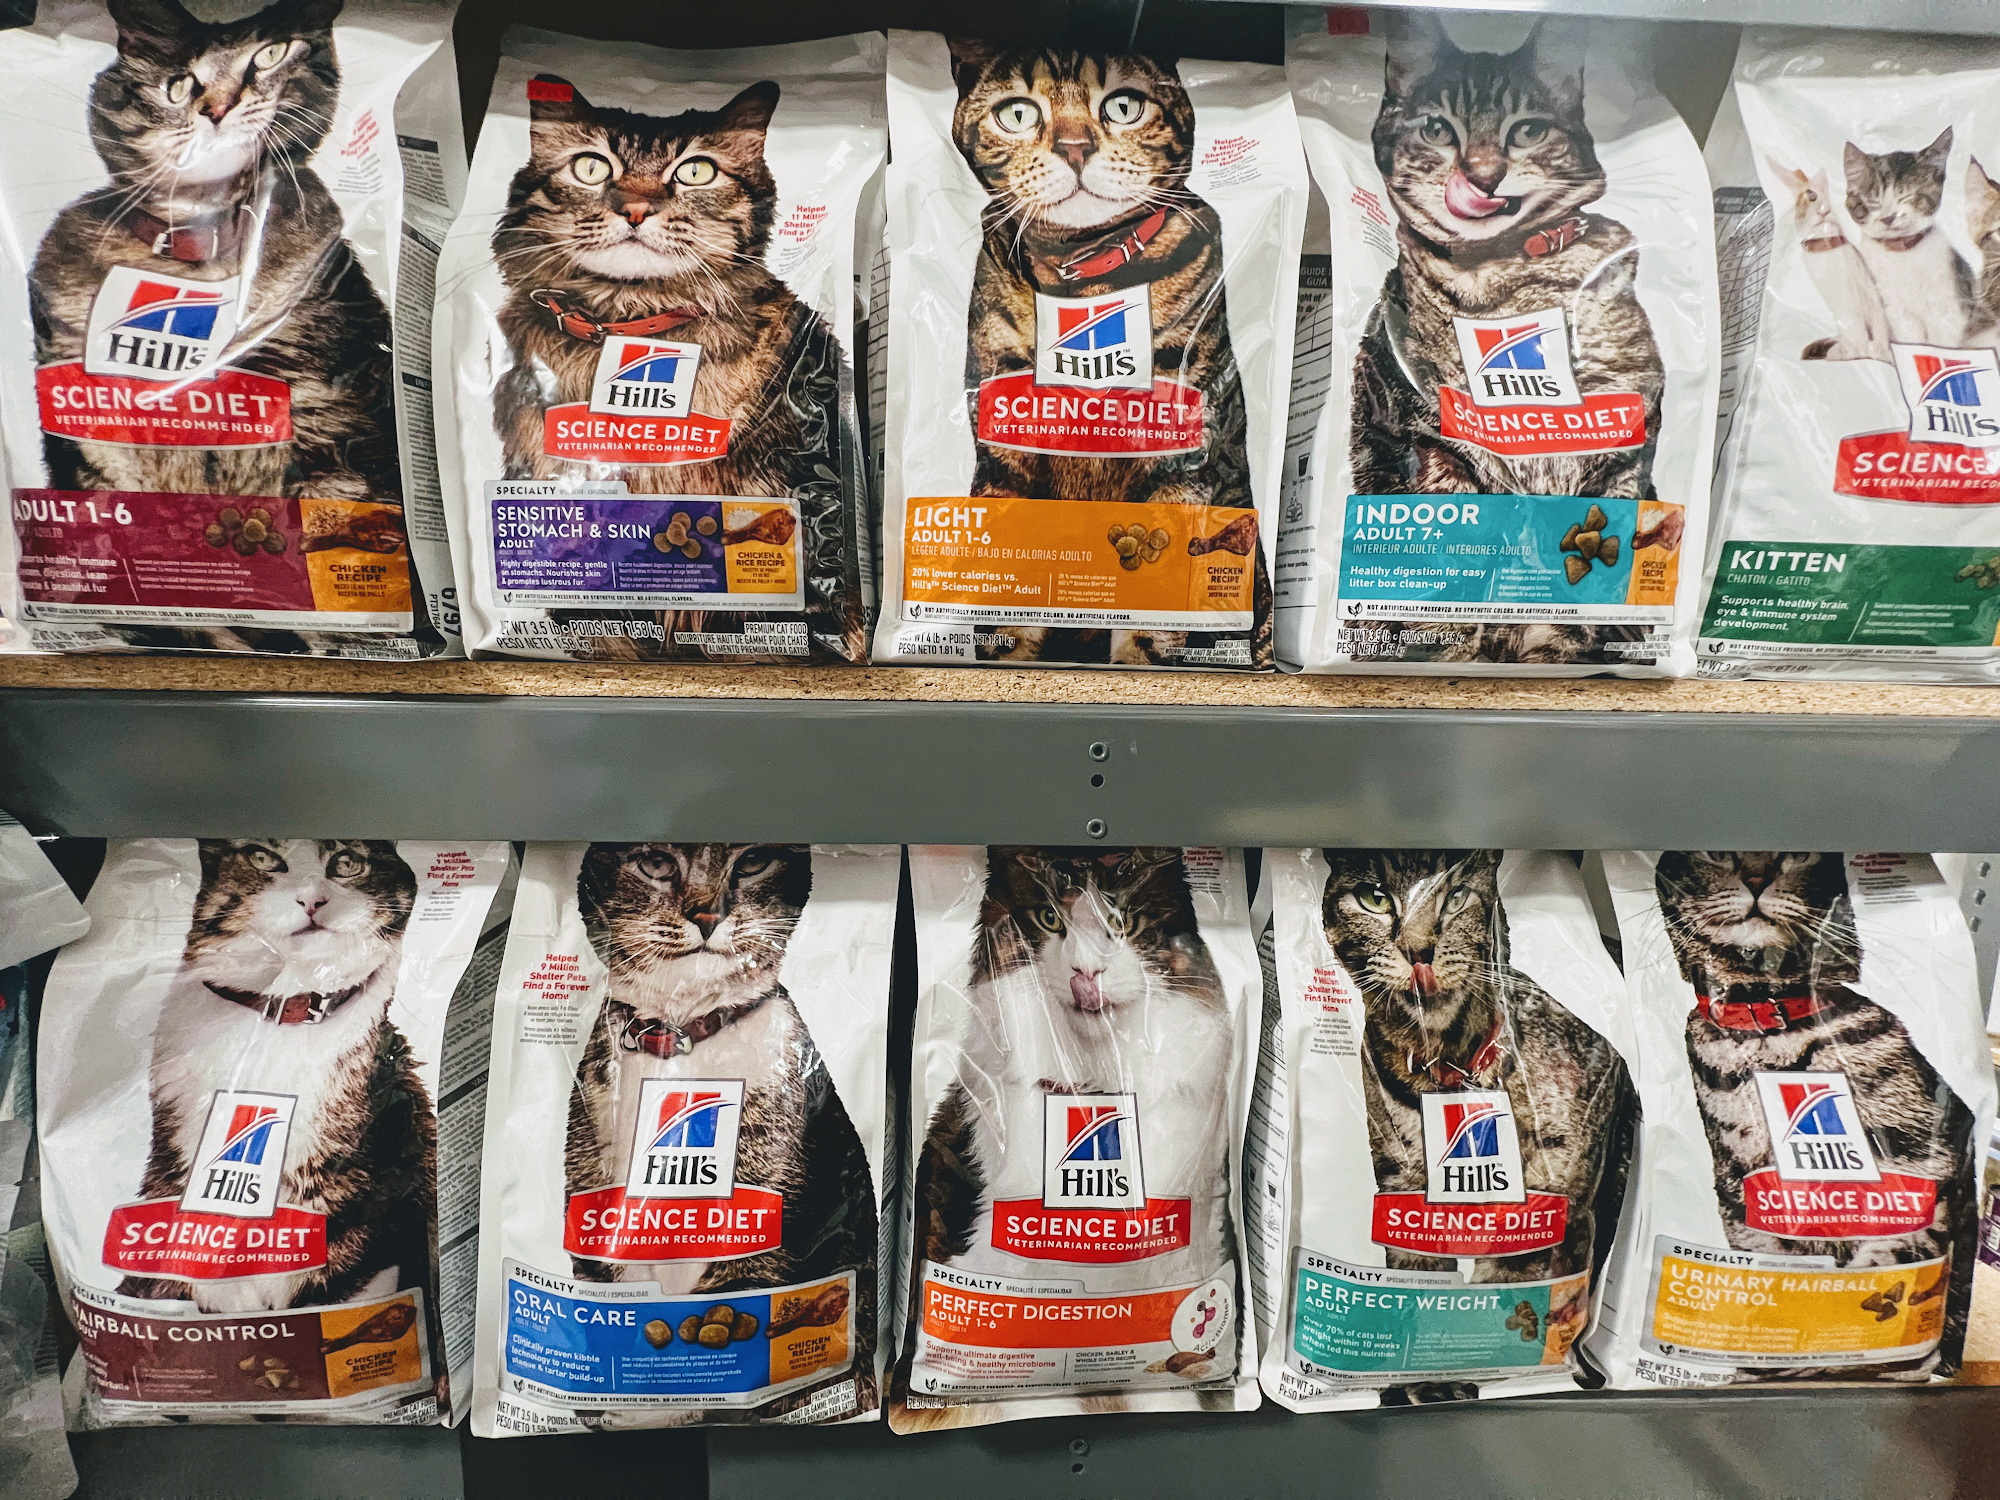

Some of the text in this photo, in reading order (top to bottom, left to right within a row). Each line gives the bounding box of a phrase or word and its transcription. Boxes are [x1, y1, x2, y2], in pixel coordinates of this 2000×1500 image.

[106, 333, 206, 371] Hill's
[1054, 352, 1136, 380] Hill's
[1480, 374, 1561, 397] Hill's
[52, 386, 272, 418] SCIENCE DIET
[607, 385, 676, 408] Hill's
[994, 397, 1189, 424] SCIENCE DIET
[1454, 402, 1630, 431] SCIENCE DIET
[54, 414, 274, 434] VETERINARIAN RECOMMENDED
[1925, 405, 2000, 437] Hill's
[557, 421, 720, 443] SCIENCE DIET
[994, 424, 1187, 440] VETERINARIAN RECOMMENDED
[1457, 424, 1633, 443] VETERINARIAN RECOMMENDED
[558, 443, 716, 453] VETERINARIAN RECOMMENDED
[1853, 451, 1988, 475] SCIENCE
[1852, 478, 1960, 489] VETERINARIAN
[13, 500, 132, 525] ADULT 1-6
[497, 507, 584, 521] SENSITIVE
[913, 507, 987, 528] LIGHT
[1356, 504, 1479, 525] INDOOR
[498, 524, 651, 539] STOMACH & SKIN
[912, 531, 991, 544] ADULT 1-6
[1353, 528, 1444, 540] ADULT 7+
[500, 540, 534, 548] ADULT
[940, 546, 969, 557] ADULTE
[978, 548, 999, 558] BAJO
[1002, 549, 1013, 558] EN
[1015, 549, 1057, 560] CALORIAS
[1060, 551, 1092, 561] ADULTO
[501, 560, 520, 568] Highly
[523, 560, 556, 568] digestible
[1731, 550, 1846, 572] KITTEN
[912, 568, 929, 577] 20%
[932, 569, 958, 578] lower
[961, 571, 1000, 580] calories
[1350, 566, 1486, 578] Healthy digestion for easy
[1727, 574, 1810, 586] CHATON GATITO
[942, 583, 979, 592] Science
[1014, 585, 1041, 595] Adult
[1350, 579, 1447, 590] litter box clean-up
[1721, 595, 1849, 610] Supports healthy brain,
[1740, 608, 1752, 616] &
[1752, 610, 1797, 619] immune
[1800, 612, 1837, 621] system
[1714, 619, 1789, 631] development.
[546, 954, 578, 963] Helped
[549, 963, 579, 971] Million
[554, 982, 590, 991] Forever
[567, 973, 586, 981] Pets
[1789, 1142, 1864, 1170] Hill's
[643, 1155, 717, 1185] Hill's
[1443, 1164, 1509, 1192] Hill's
[201, 1169, 260, 1204] Hill's
[1061, 1168, 1129, 1197] Hill's
[1757, 1190, 1924, 1211] SCIENCE DIET
[580, 1208, 768, 1230] SCIENCE DIET
[1007, 1214, 1178, 1239] SCIENCE DIET
[1387, 1209, 1557, 1230] SCIENCE DIET
[1761, 1215, 1926, 1225] VETERINARIAN RECOMMENDED
[121, 1222, 310, 1248] SCIENCE DIET
[579, 1235, 766, 1246] VETERINARIAN RECOMMENDED
[1007, 1237, 1177, 1250] VETERINARIAN RECOMMENDED
[1388, 1231, 1554, 1242] VETERINARIAN RECOMMENDED
[119, 1251, 310, 1264] VETERINARIAN RECOMMENDED
[1674, 1246, 1754, 1265] SPECIALTY
[933, 1269, 1001, 1290] SPECIALTY
[1308, 1257, 1382, 1282] SPECIALTY
[1671, 1265, 1878, 1293] URINARY HAIRBALL
[515, 1267, 574, 1293] SPECIALTY
[1306, 1277, 1501, 1311] PERFECT WEIGHT
[1667, 1296, 1716, 1312] ADULT
[1668, 1282, 1777, 1307] CONTROL
[514, 1290, 635, 1326] ORAL CARE
[930, 1290, 1132, 1321] PERFECT DIGESTION
[1305, 1296, 1351, 1314] ADULT
[514, 1306, 551, 1325] ADULT
[930, 1309, 996, 1329] ADULT 1-6
[168, 1323, 295, 1342] CONTROL
[1303, 1315, 1392, 1340] Over 70% of cats lost
[513, 1334, 600, 1362] Clinically proven kibble
[926, 1341, 961, 1355] Supports
[964, 1351, 997, 1359] ultimate
[512, 1346, 590, 1371] technology to reduce
[926, 1352, 966, 1366] well-being
[977, 1361, 1006, 1369] healthy
